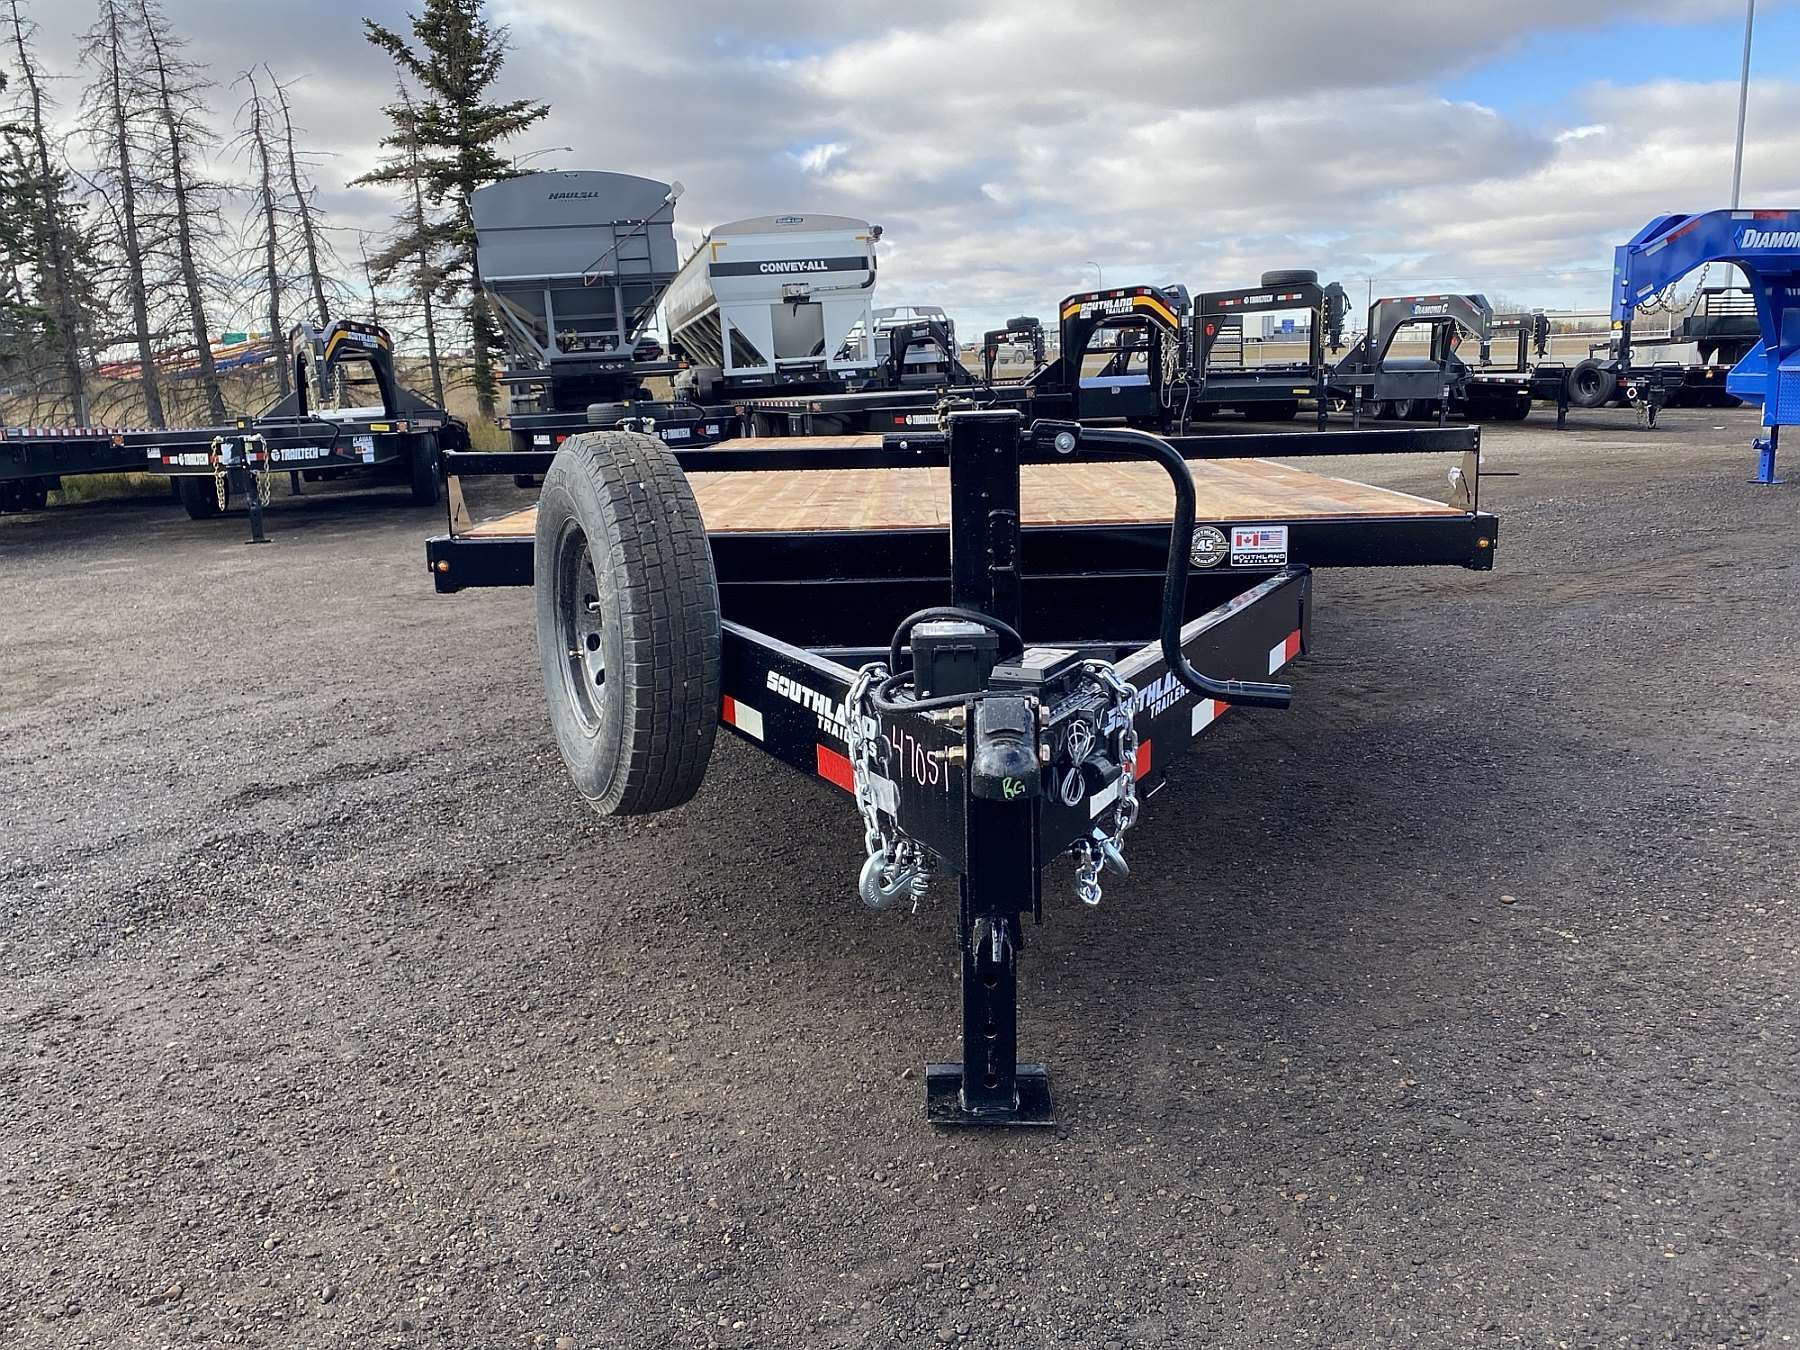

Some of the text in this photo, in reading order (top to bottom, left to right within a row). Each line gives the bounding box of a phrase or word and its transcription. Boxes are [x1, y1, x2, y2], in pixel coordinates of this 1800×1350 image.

[760, 260, 828, 273] CONVEY-ALL
[1080, 297, 1133, 313] SOUTHLAND
[1105, 306, 1134, 314] TRAILERS
[1414, 305, 1442, 315] DIAMOND
[280, 447, 319, 461] TRAILTECH
[1196, 539, 1214, 552] 45
[1233, 553, 1286, 561] SOUTHLAND
[766, 670, 877, 741] SOUTHLAD
[817, 714, 878, 758] TRAILS
[892, 724, 949, 792] 47051
[1002, 776, 1026, 799] RG
